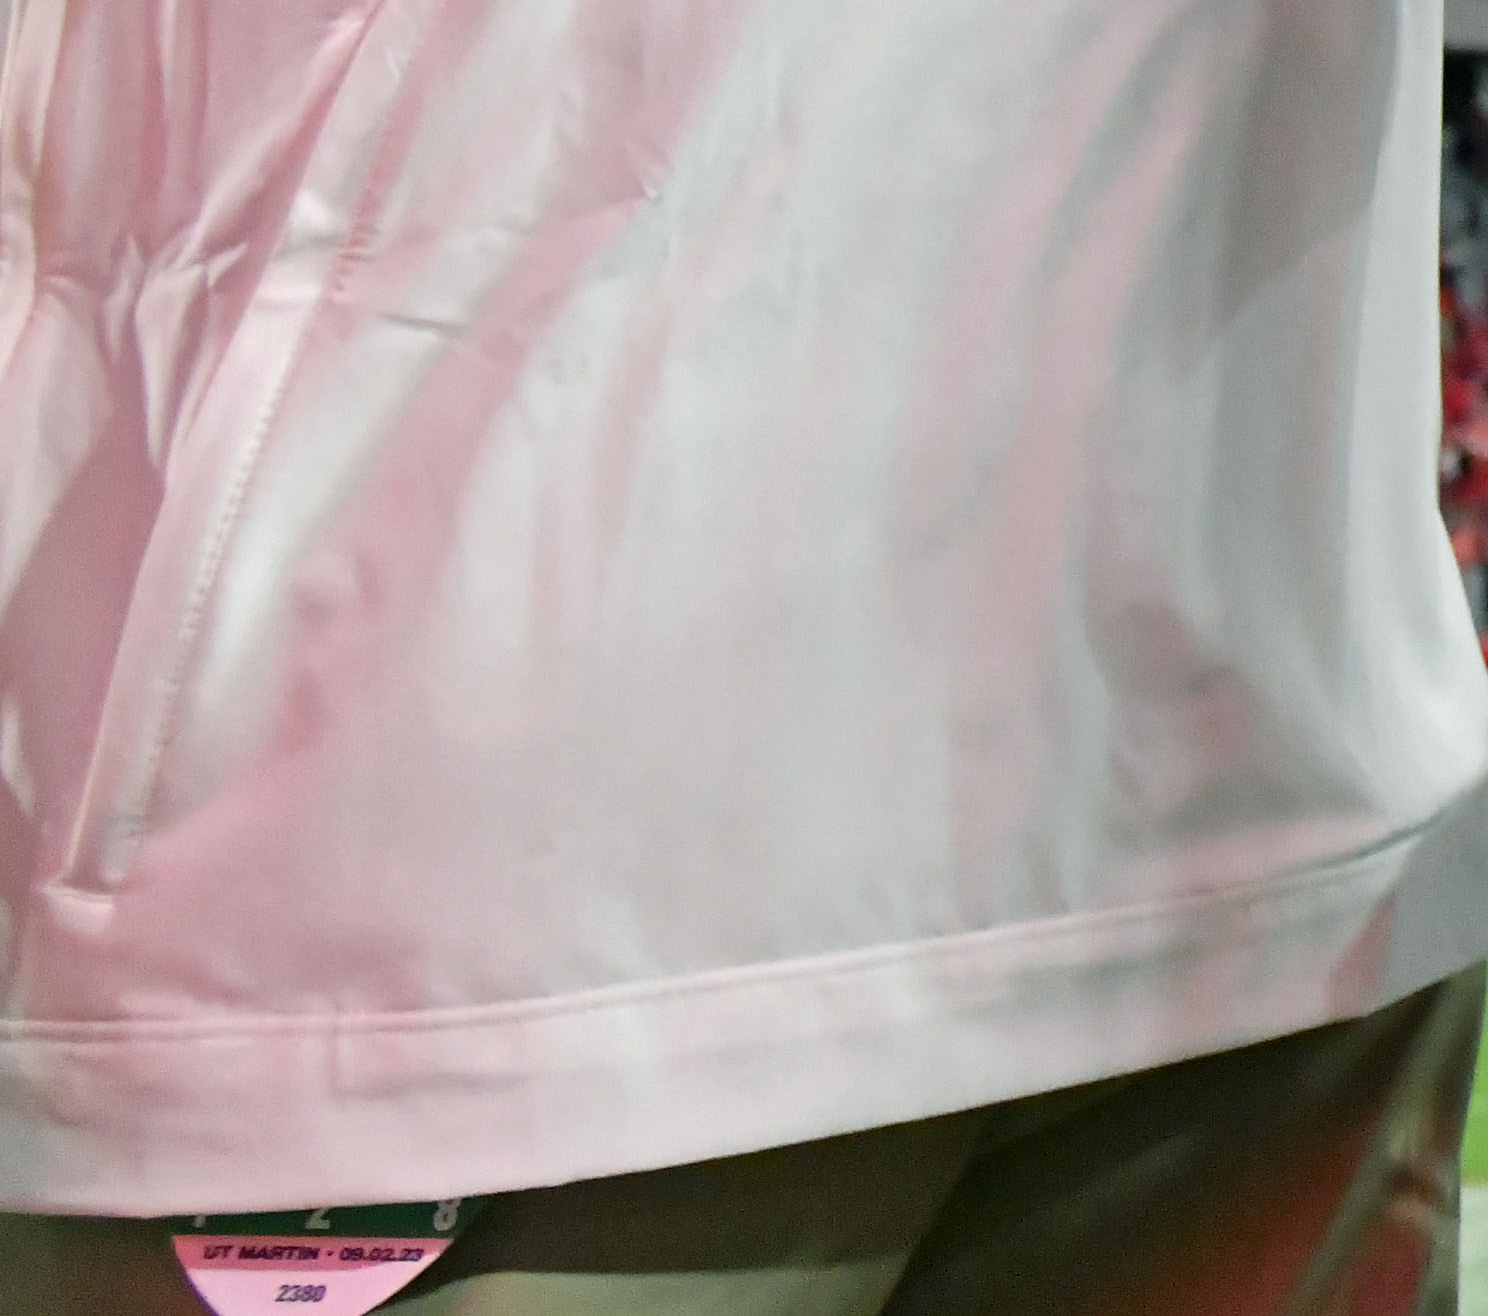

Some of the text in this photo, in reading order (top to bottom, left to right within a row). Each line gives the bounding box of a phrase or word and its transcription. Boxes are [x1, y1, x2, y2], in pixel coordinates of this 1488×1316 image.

[203, 1245, 424, 1263] UT MARTIN 09.02.23
[274, 1284, 327, 1303] 2380
